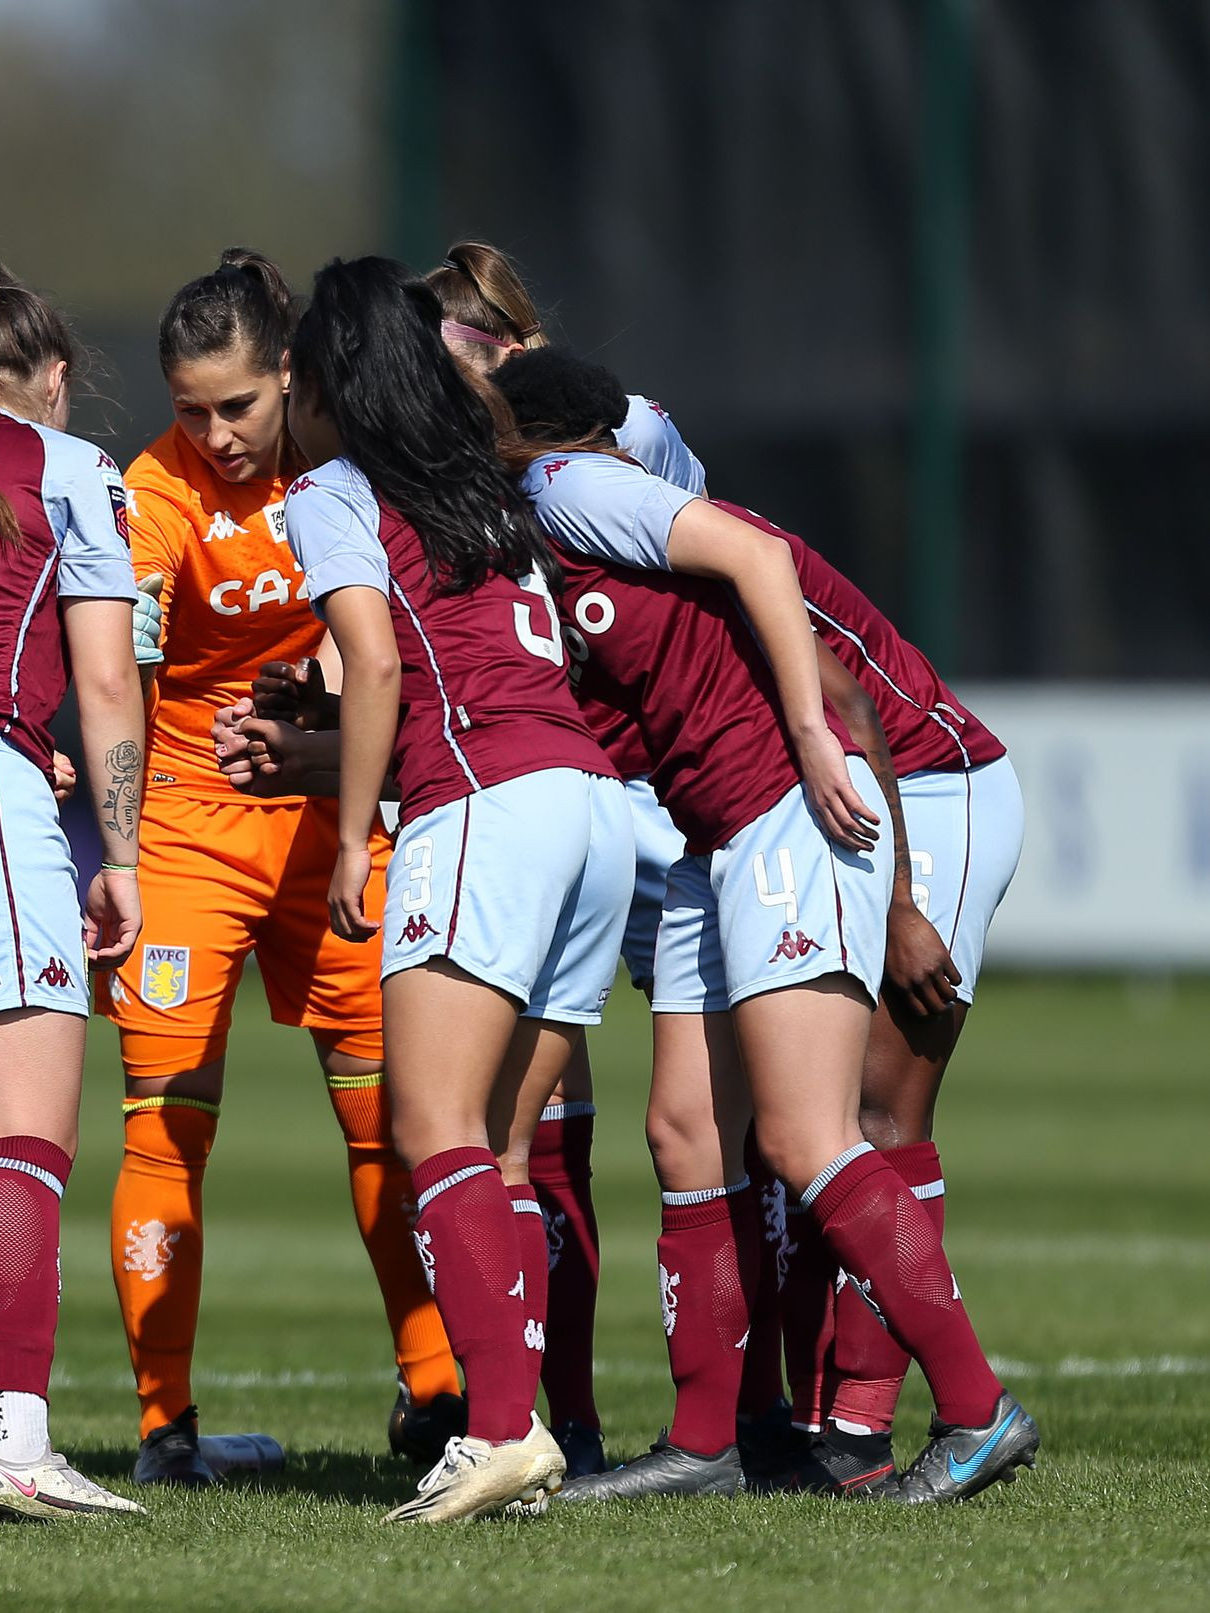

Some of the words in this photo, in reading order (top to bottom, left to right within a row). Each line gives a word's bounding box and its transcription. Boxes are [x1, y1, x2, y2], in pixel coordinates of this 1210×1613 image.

[401, 835, 433, 912] 3
[752, 847, 799, 925] 4
[147, 949, 186, 962] AVFC
